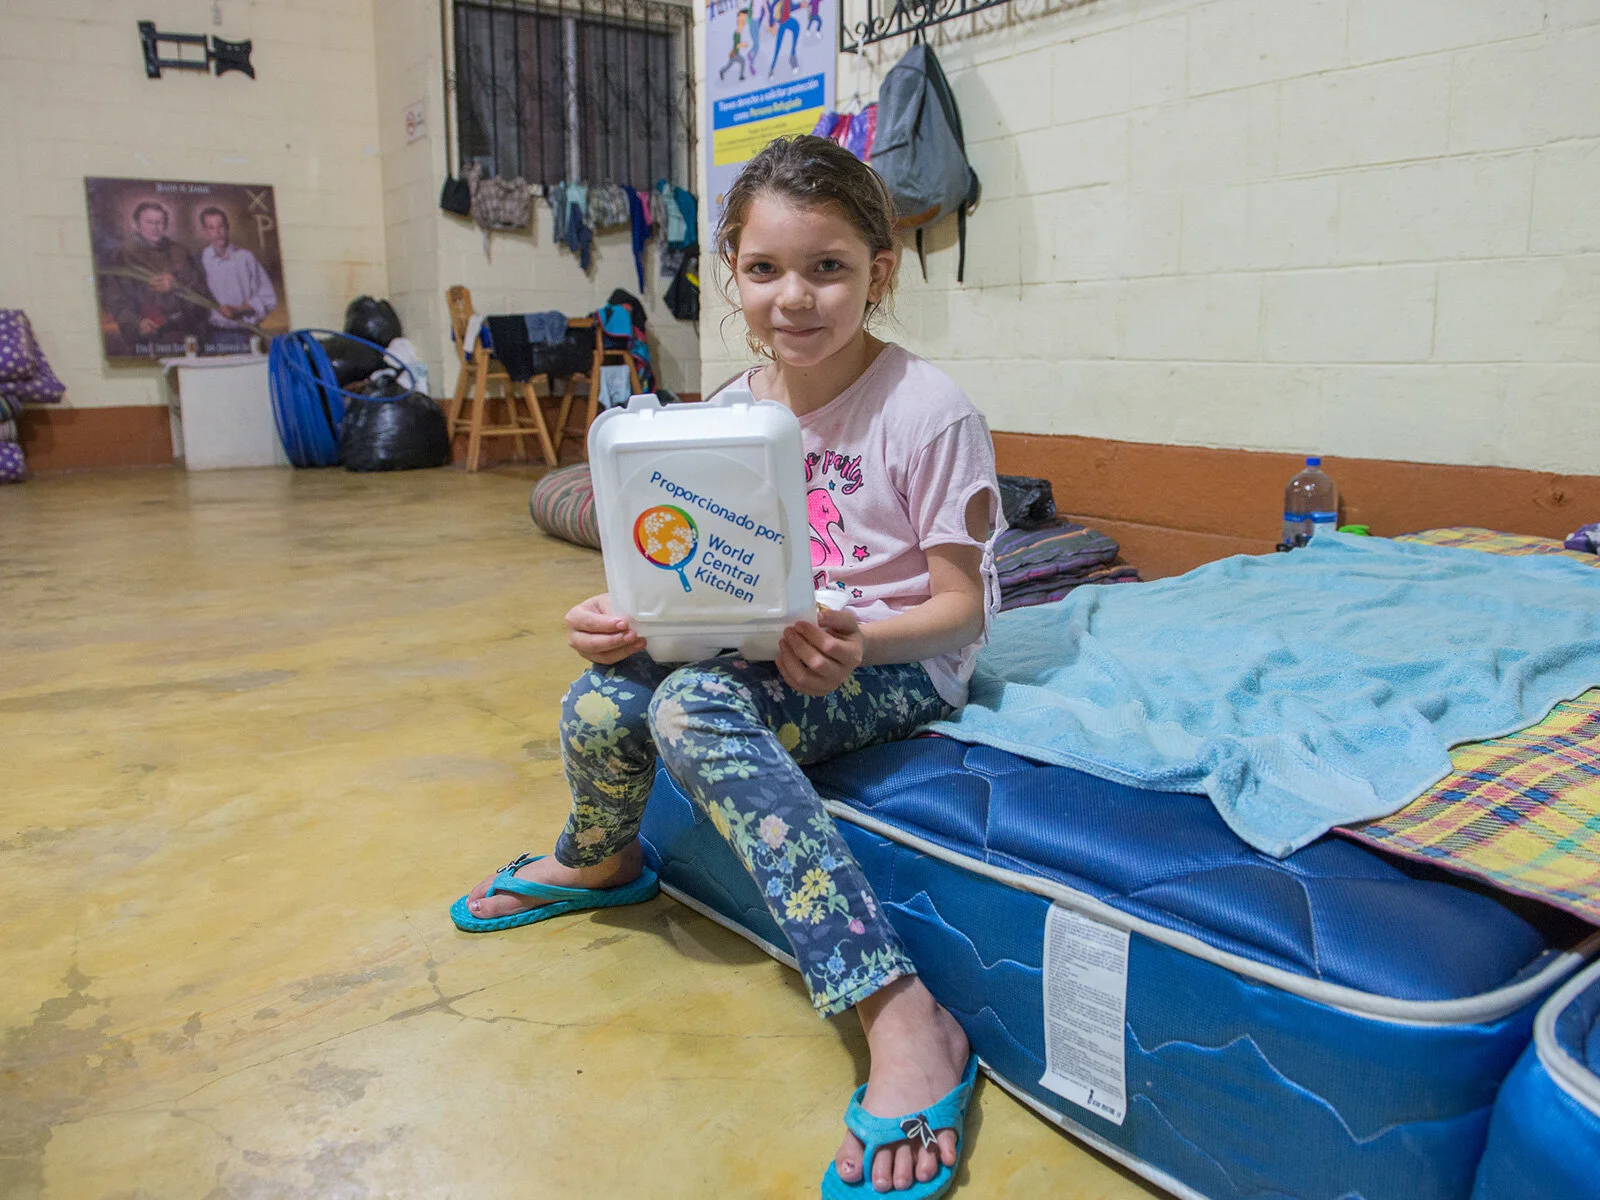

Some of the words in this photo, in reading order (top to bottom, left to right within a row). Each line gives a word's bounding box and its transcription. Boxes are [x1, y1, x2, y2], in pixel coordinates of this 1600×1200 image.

[822, 450, 864, 495] party
[650, 471, 755, 531] Proporcionado
[754, 524, 785, 545] por:
[708, 533, 755, 566] World
[694, 566, 755, 603] Kitchen
[702, 551, 760, 587] Central
